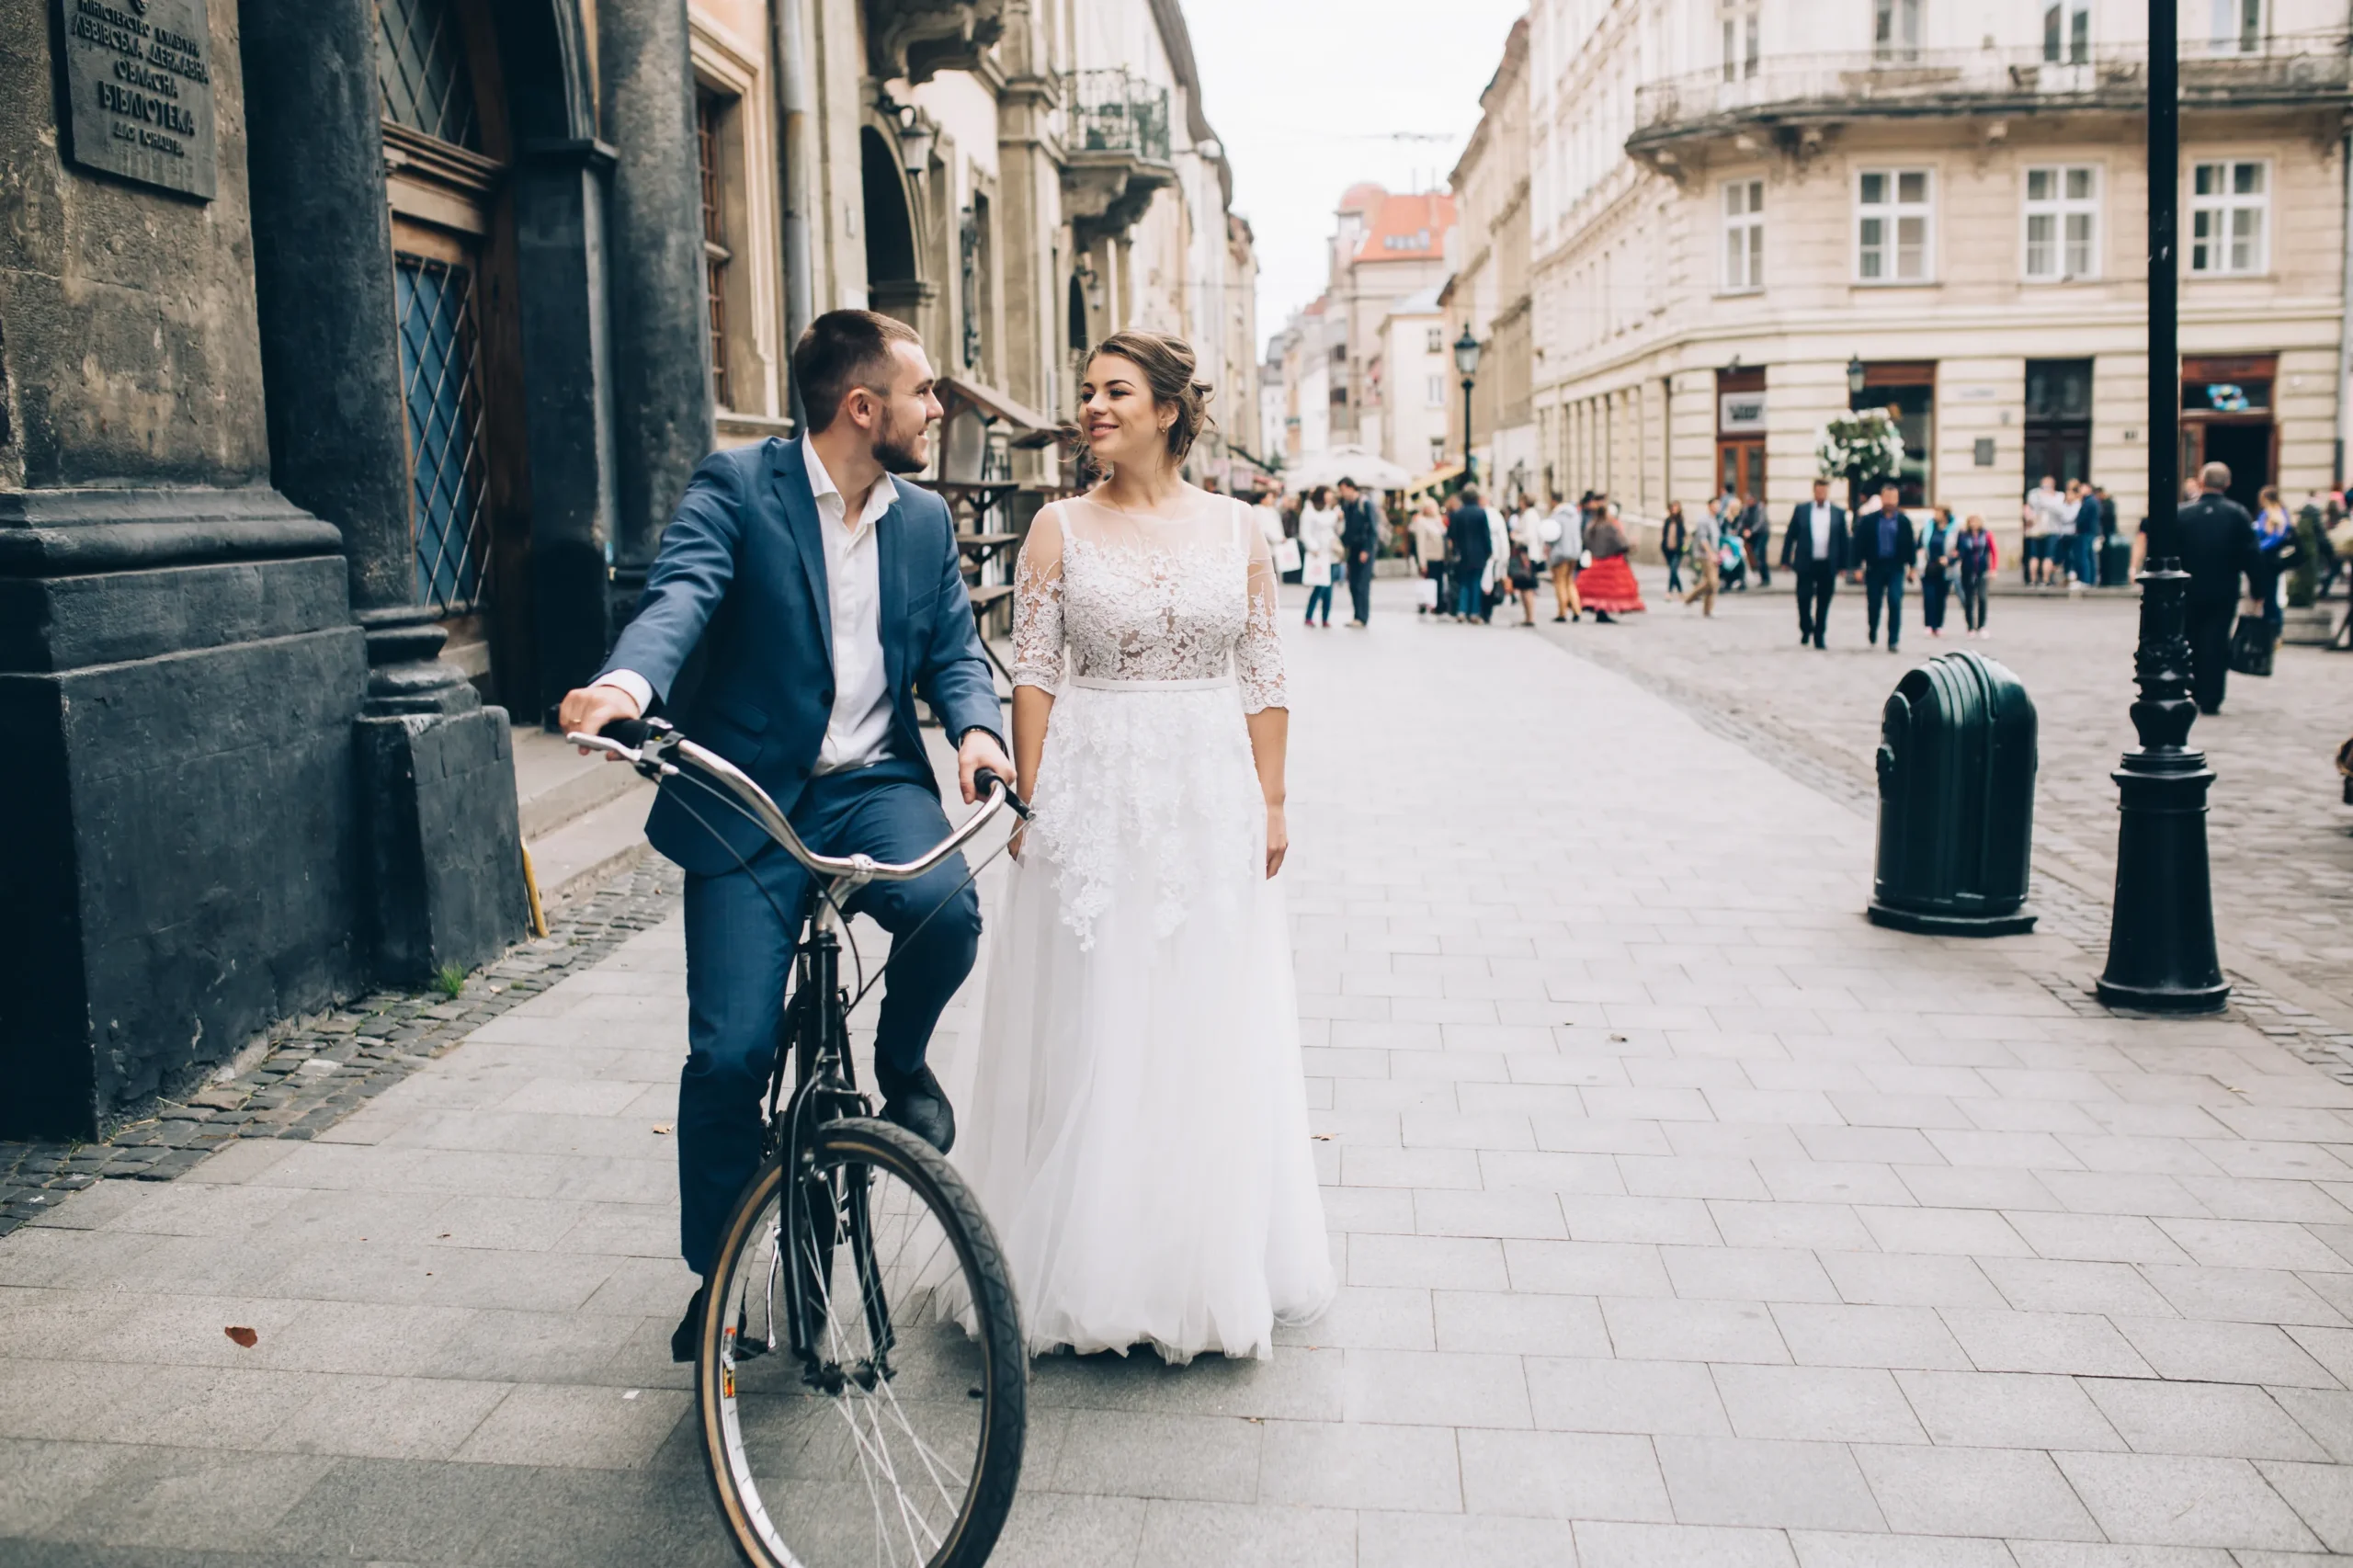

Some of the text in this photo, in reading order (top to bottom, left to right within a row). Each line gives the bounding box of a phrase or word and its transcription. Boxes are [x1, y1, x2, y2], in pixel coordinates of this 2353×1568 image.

[73, 13, 209, 85] ЛЬВІВСЬКА ДЕРЖАВНА
[114, 58, 178, 98] ОБЛАСНА
[98, 80, 195, 136] БІБЛІОТЕКА
